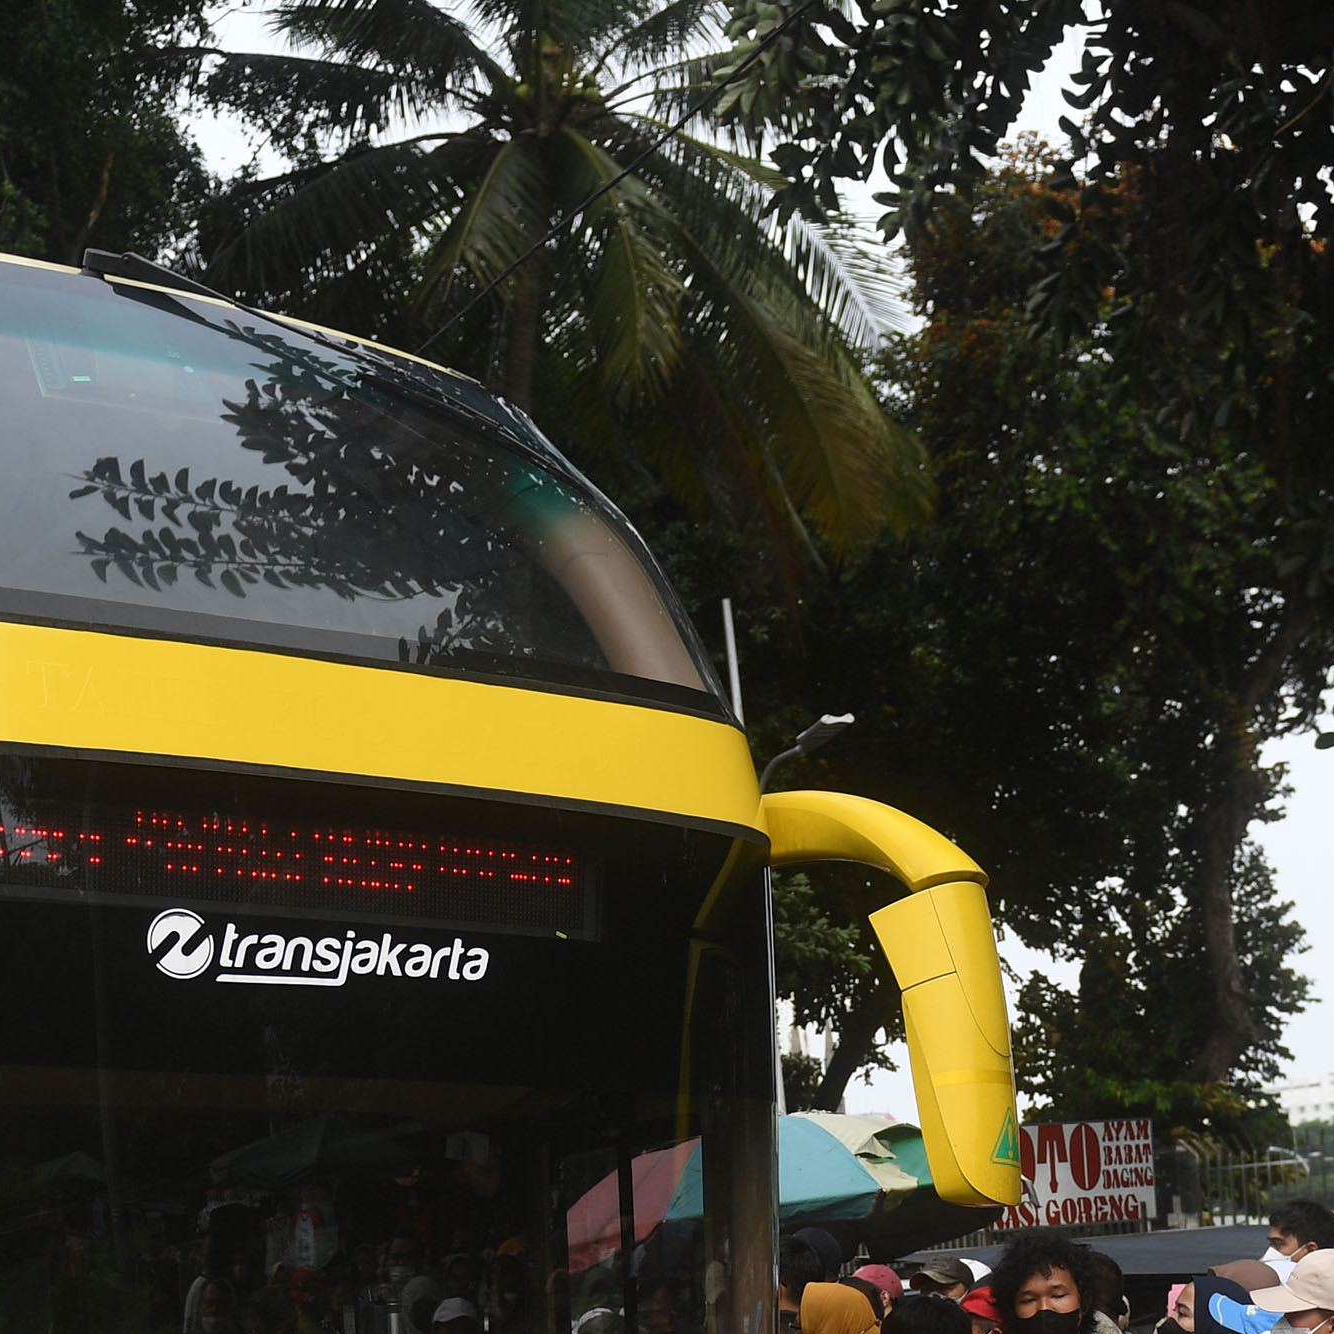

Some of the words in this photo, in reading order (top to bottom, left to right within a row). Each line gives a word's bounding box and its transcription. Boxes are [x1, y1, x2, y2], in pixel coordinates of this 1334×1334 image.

[216, 922, 489, 987] transjakarta
[1102, 1119, 1149, 1142] AYAM
[1019, 1122, 1101, 1196] OTO
[1104, 1143, 1152, 1166] BABAT
[1102, 1166, 1154, 1190] DAGING
[1045, 1193, 1140, 1227] GORENG
